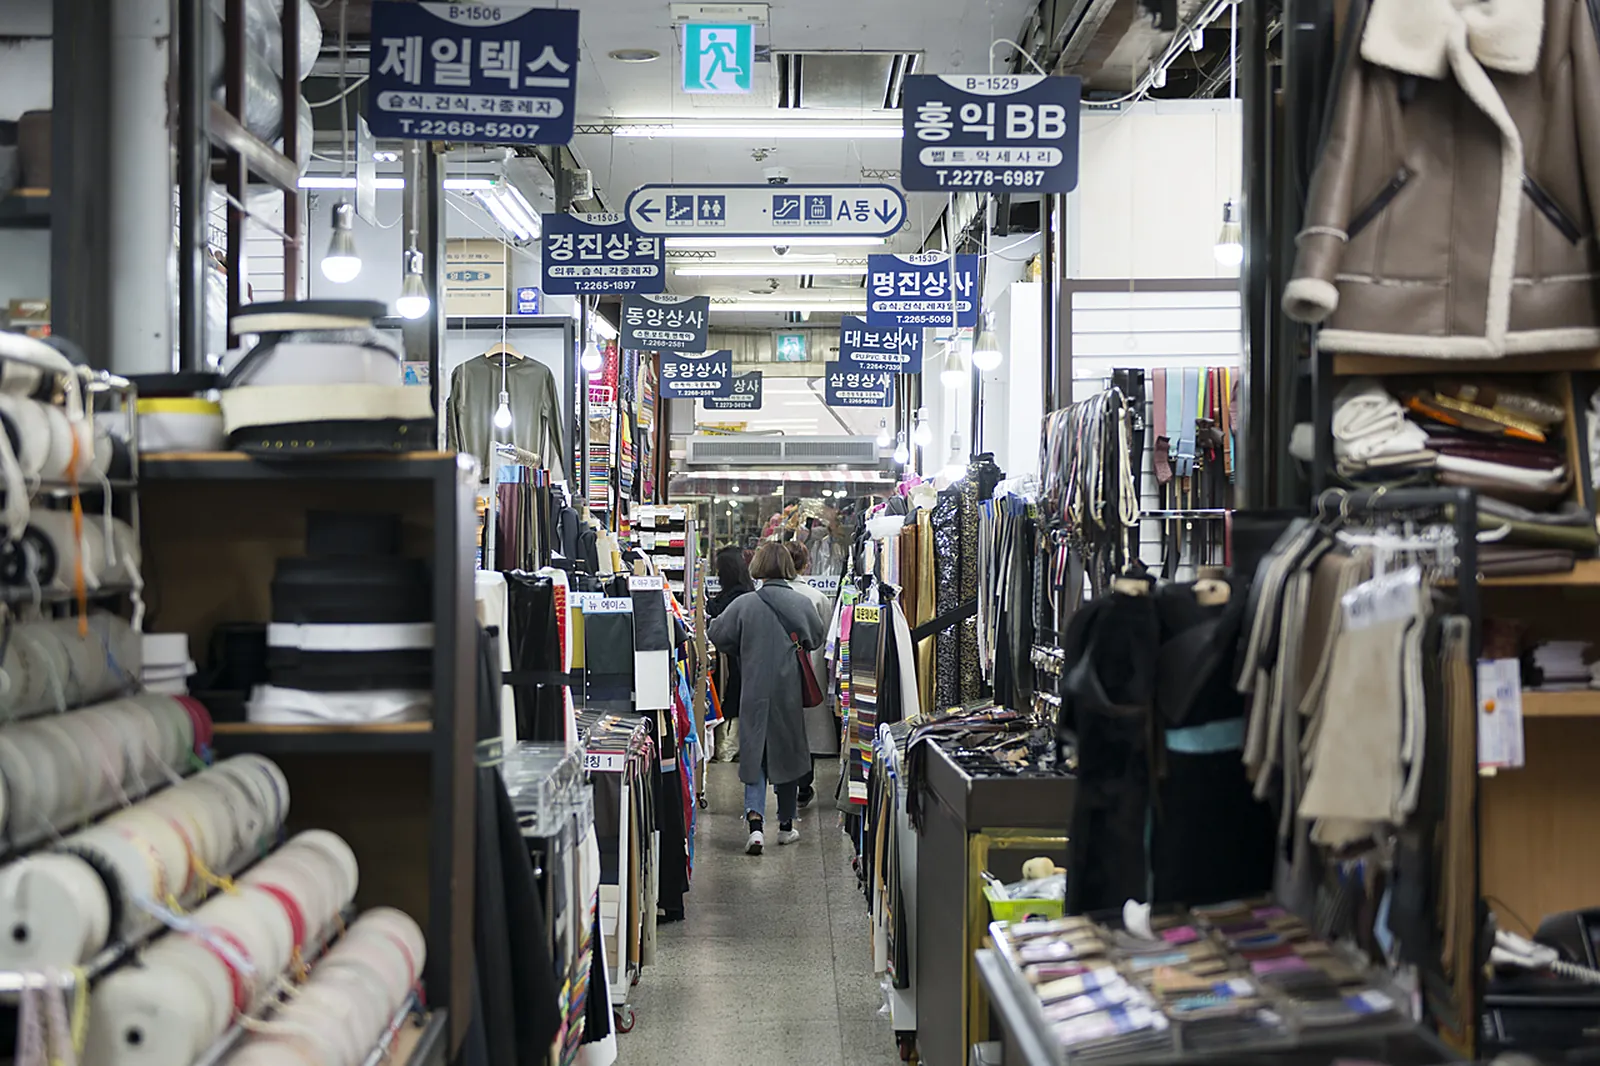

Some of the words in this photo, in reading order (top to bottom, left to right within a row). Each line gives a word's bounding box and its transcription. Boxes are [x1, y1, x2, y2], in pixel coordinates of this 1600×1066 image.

[378, 36, 570, 90] 제일텍스
[966, 77, 1019, 90] B-1529
[399, 119, 540, 139] T.2268-5207
[914, 101, 1067, 141] 홍익BB
[936, 170, 1045, 186] T.2278-6987
[836, 199, 870, 222] A동
[548, 233, 660, 261] 경진상회
[574, 281, 636, 290] T.2265-1897
[872, 271, 974, 297] 명진상사
[625, 306, 704, 330] 동양상사
[844, 330, 918, 351] 대보상사
[662, 362, 728, 379] 동양상사
[829, 373, 891, 389] 삼영상사
[807, 578, 837, 588] Gate
[600, 600, 627, 610] 에이스
[607, 756, 612, 767] 1
